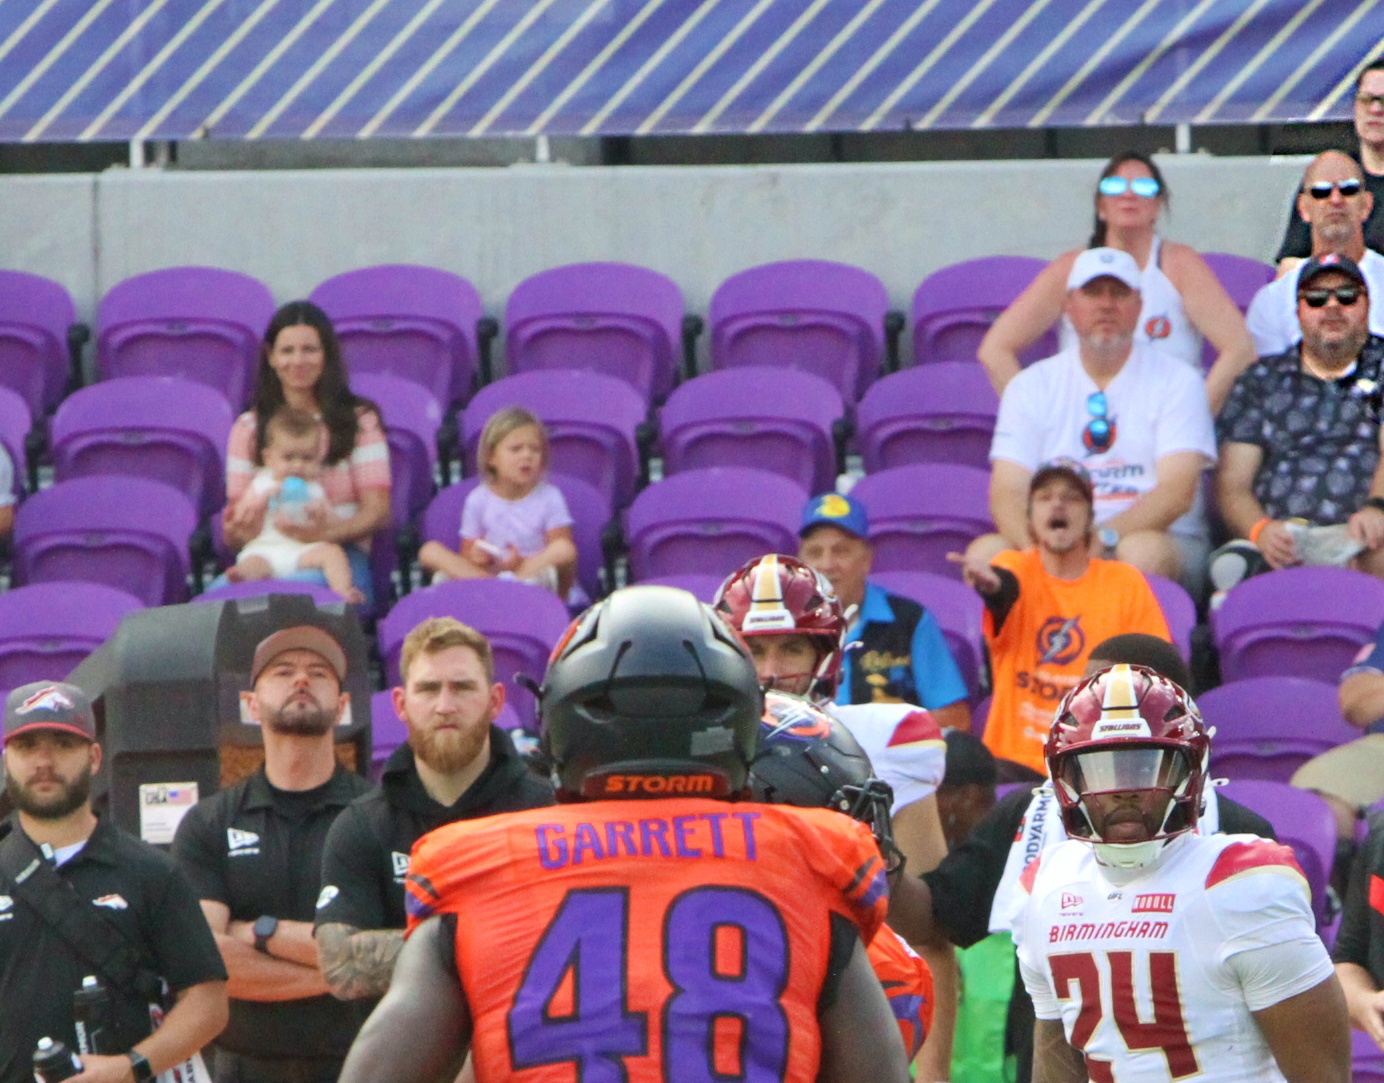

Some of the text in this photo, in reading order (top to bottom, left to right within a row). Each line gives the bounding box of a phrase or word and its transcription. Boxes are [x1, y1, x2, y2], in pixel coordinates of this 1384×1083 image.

[605, 775, 714, 793] STORM
[535, 812, 762, 870] GARRETT
[1049, 921, 1169, 943] BIRMINGHAM
